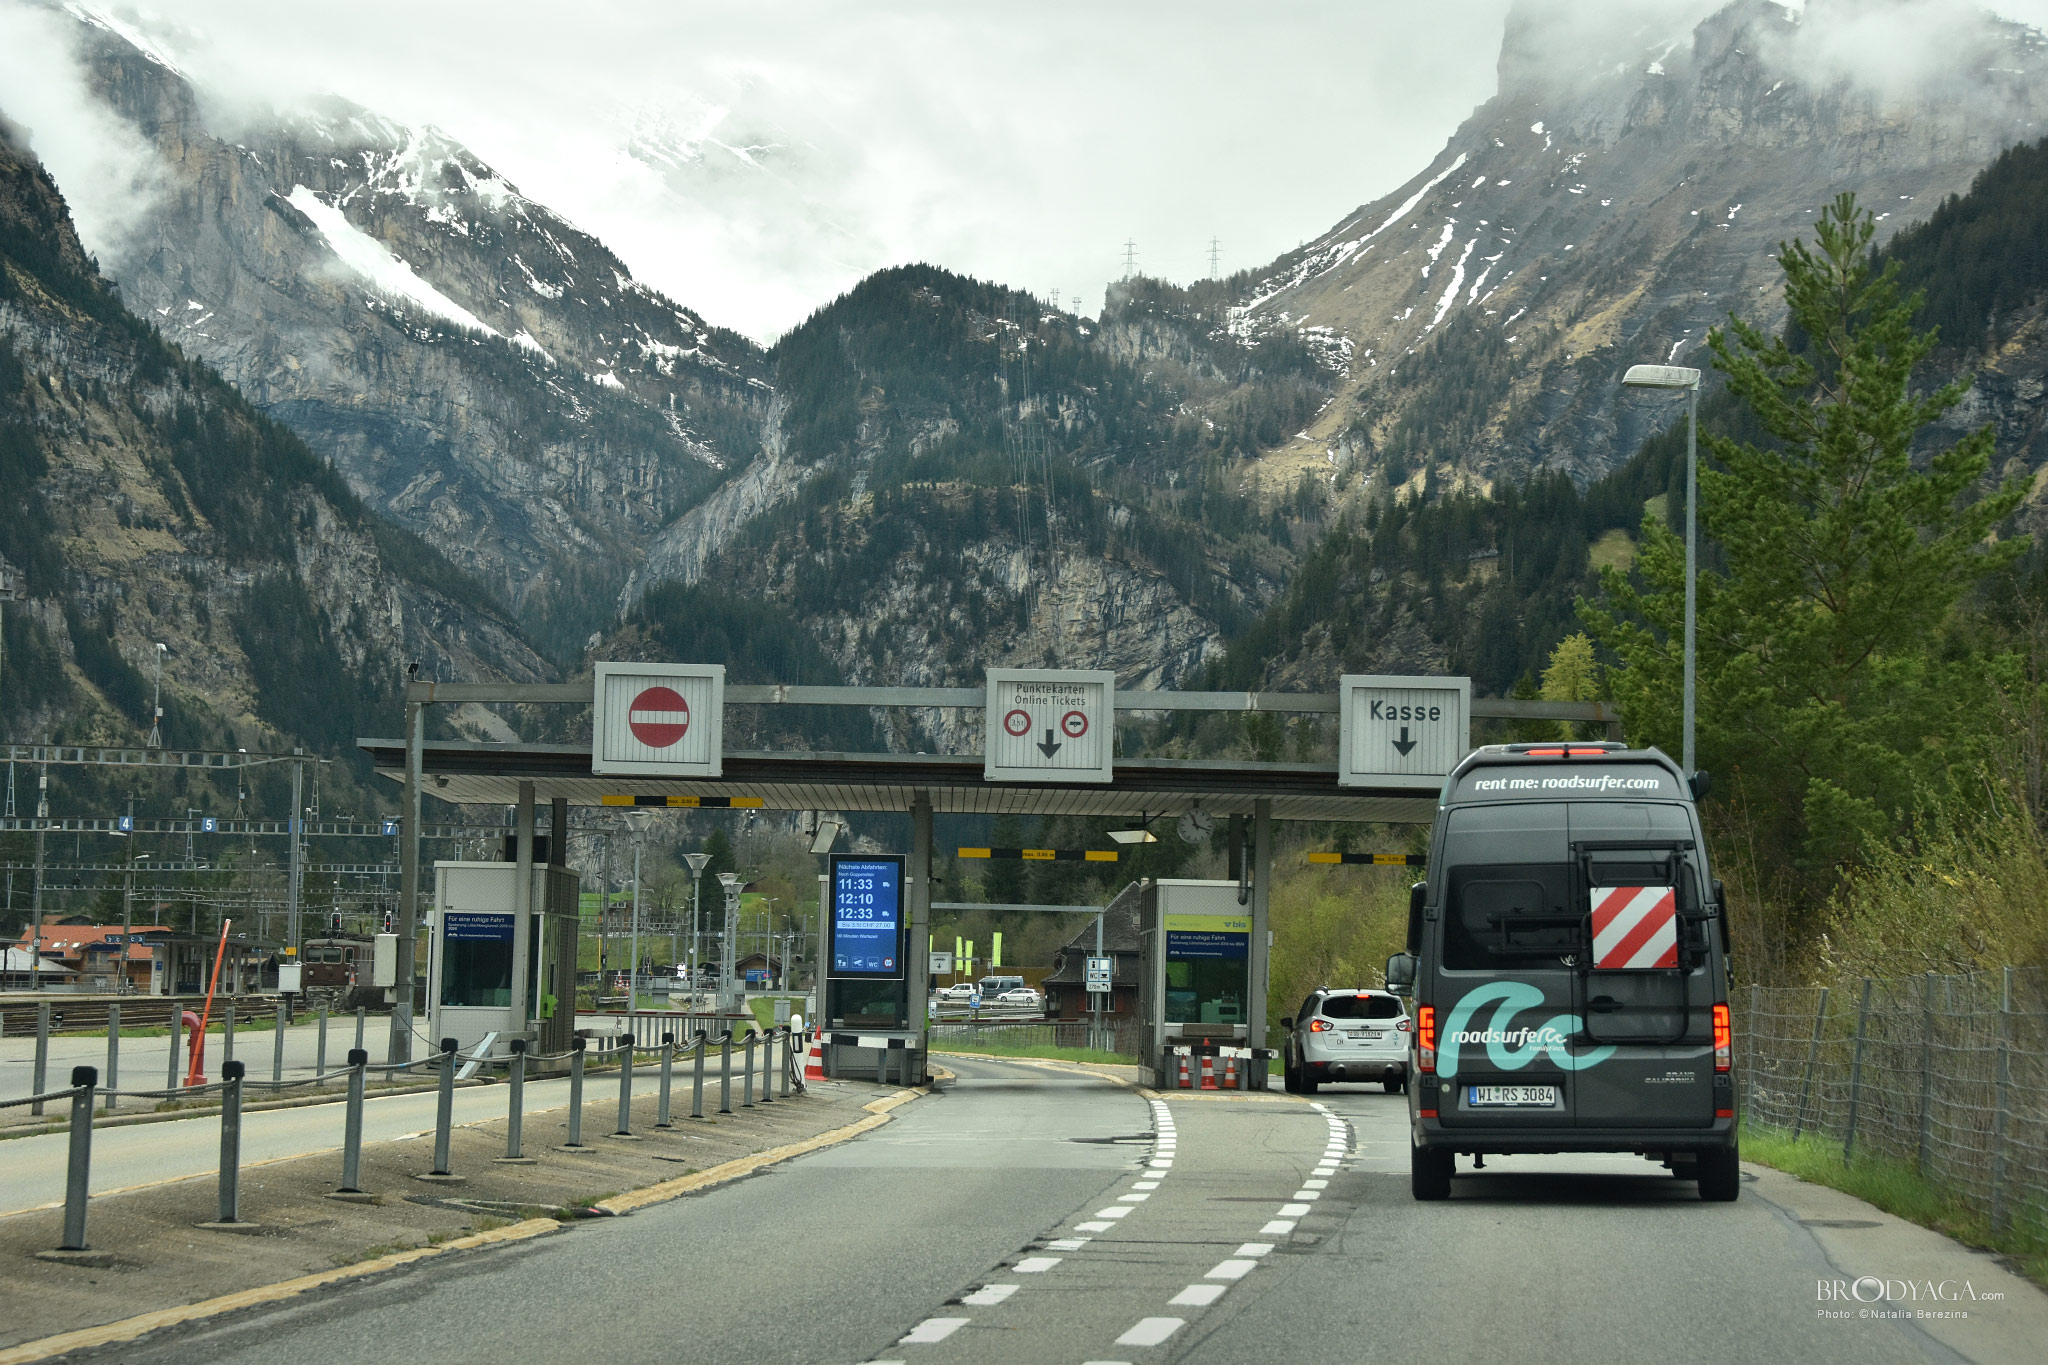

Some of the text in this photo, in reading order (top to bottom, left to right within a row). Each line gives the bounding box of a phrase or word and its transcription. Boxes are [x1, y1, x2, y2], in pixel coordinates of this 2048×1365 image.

[1017, 684, 1085, 694] Punktekarten
[1015, 695, 1085, 705] Online Tickets
[1371, 700, 1440, 721] Kasse
[1475, 775, 1659, 791] rent me: roadsurfer.com
[122, 818, 129, 829] 4
[206, 819, 212, 830] 5
[386, 822, 393, 833] 7
[839, 879, 873, 889] 11:33
[839, 893, 873, 904] 12:10
[838, 907, 873, 919] 12:33
[1478, 1088, 1553, 1102] WI RS 3084
